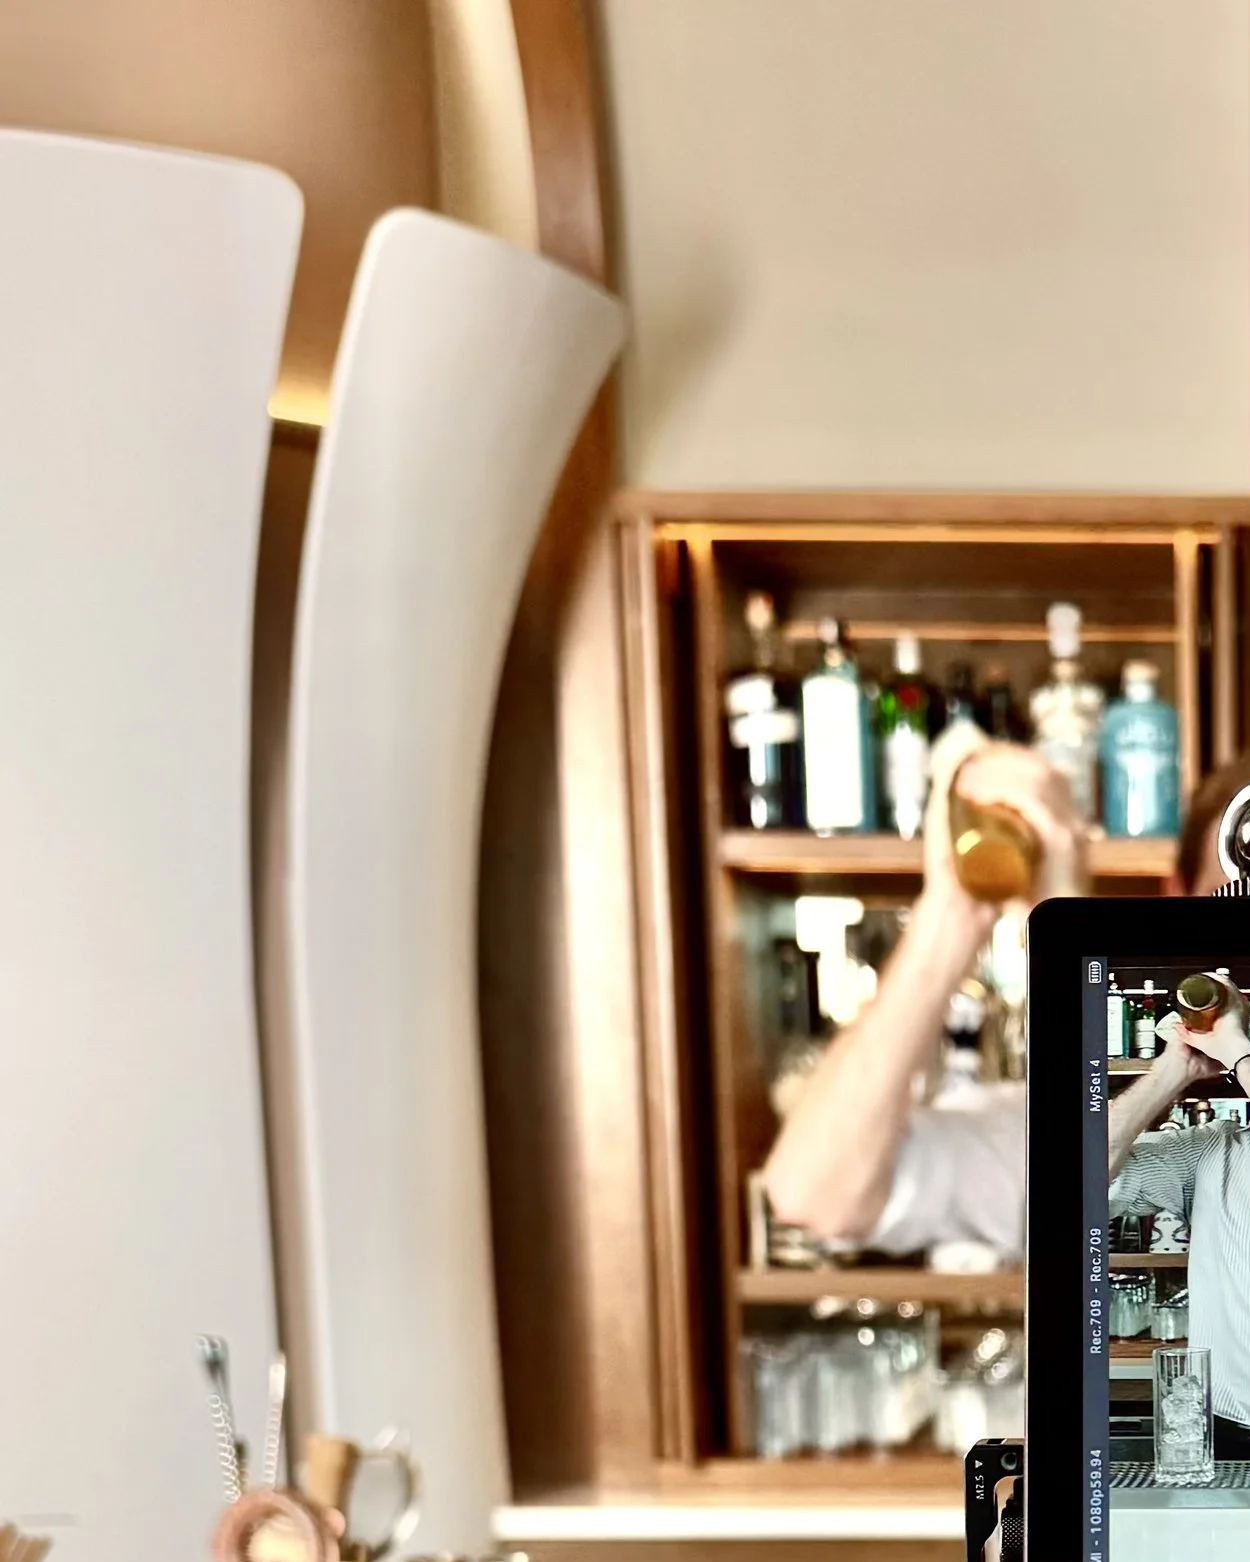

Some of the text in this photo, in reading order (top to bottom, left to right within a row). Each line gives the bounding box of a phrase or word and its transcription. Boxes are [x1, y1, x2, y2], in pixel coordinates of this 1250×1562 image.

[1089, 1073, 1104, 1112] MySet
[1089, 1228, 1102, 1282] Rec.709
[1089, 1299, 1102, 1354] Rec.709
[975, 1474, 985, 1500] M2.5
[1089, 1449, 1105, 1534] 1080p59.94
